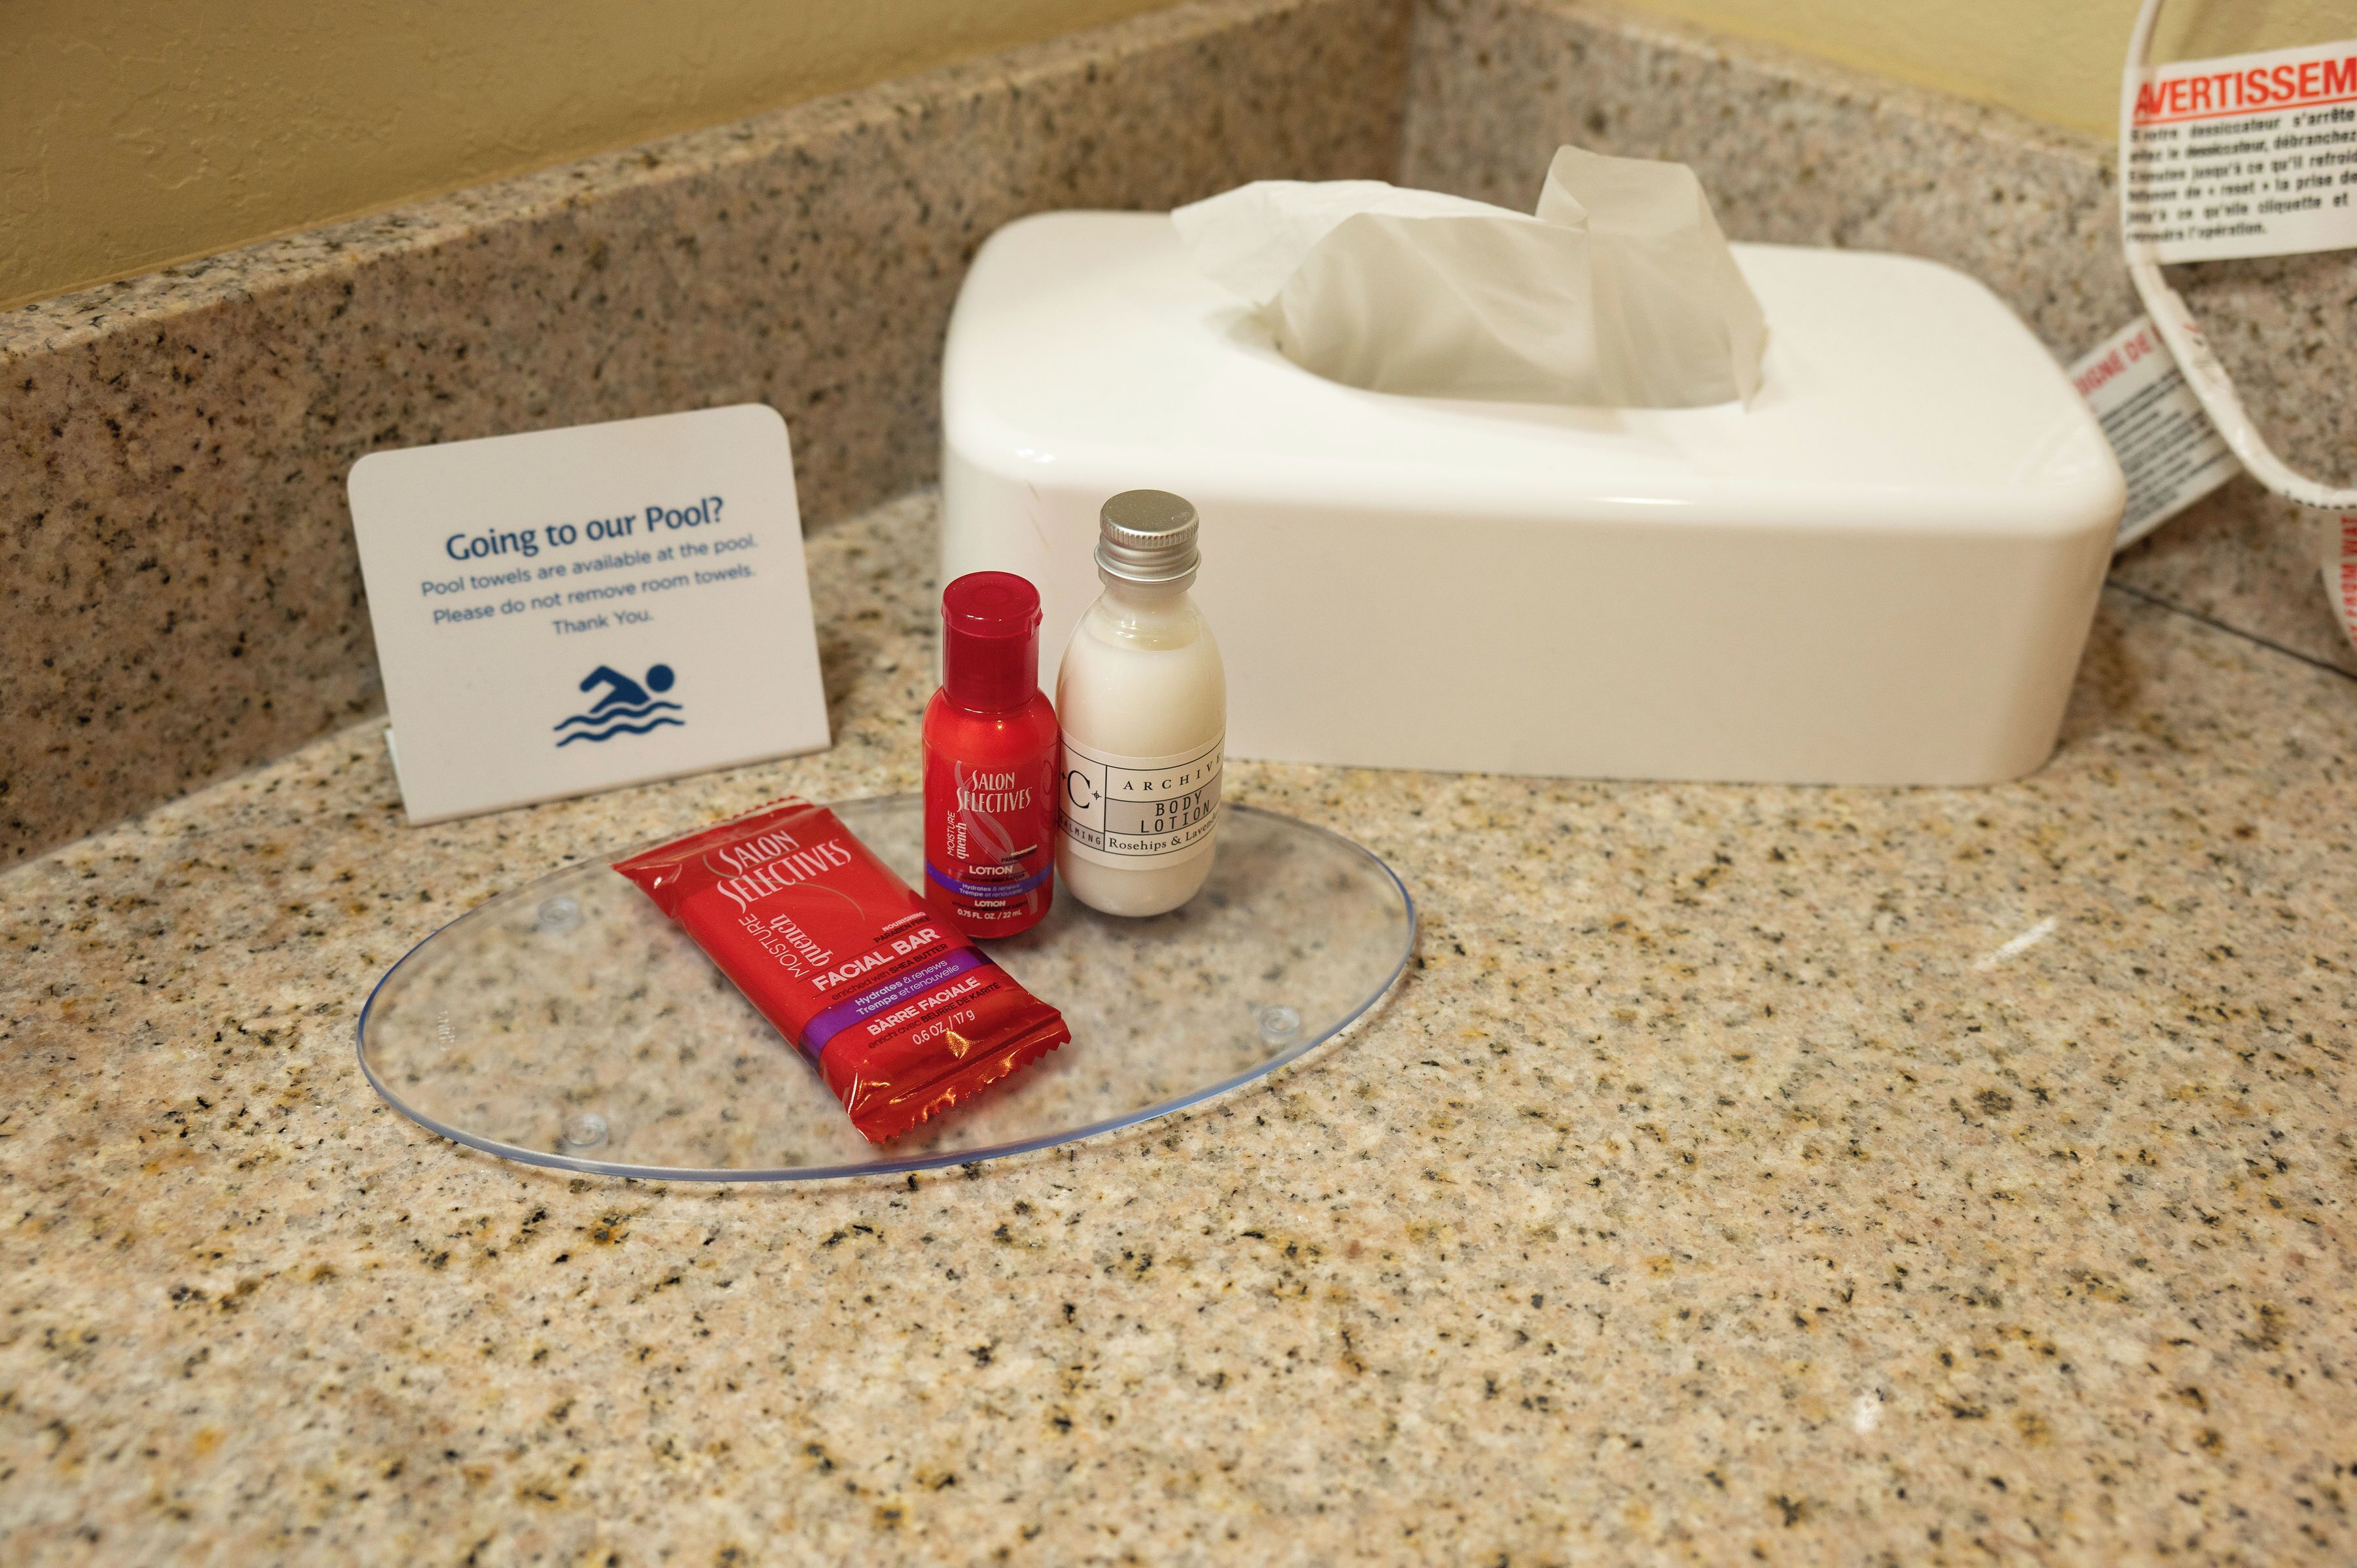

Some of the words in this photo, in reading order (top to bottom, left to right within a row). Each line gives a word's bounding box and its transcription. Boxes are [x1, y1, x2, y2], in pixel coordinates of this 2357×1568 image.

[446, 527, 539, 561] Going
[545, 524, 577, 547] to
[586, 515, 636, 541] our
[645, 495, 724, 533] Pool?
[421, 576, 466, 596] Pool
[469, 568, 532, 591] towels
[537, 564, 567, 581] are
[572, 549, 652, 575] available
[657, 545, 675, 562] at
[679, 541, 708, 558] the
[714, 532, 758, 556] pool.
[432, 604, 496, 625] Please
[500, 598, 526, 615] do
[531, 593, 562, 610] not
[568, 582, 637, 604] remove
[640, 574, 690, 593] room
[694, 562, 757, 585] towels.
[551, 613, 610, 637] Thank
[613, 610, 654, 626] You.
[972, 769, 1015, 791] SALON
[1122, 752, 1221, 792] ARCHIVE
[957, 787, 1032, 813] SELECTIVES
[1141, 799, 1210, 834] LOTION
[1154, 790, 1203, 817] BODY
[719, 830, 800, 876] SALON
[947, 811, 956, 857] MOISTURE
[957, 822, 970, 860] quench
[1108, 837, 1167, 852] Rosehips
[1171, 835, 1182, 847] &
[716, 839, 852, 915] SELECTIVES
[962, 883, 991, 892] Hydrates
[969, 864, 1014, 876] LOTION
[959, 888, 983, 897] Trempe
[873, 923, 913, 943] PARABEN
[911, 916, 932, 927] FREE
[881, 911, 926, 932] NOURISHING
[957, 908, 972, 917] 0.75
[738, 913, 810, 979] MOISTURE
[769, 913, 834, 967] quench
[811, 951, 895, 992] FACIAL
[890, 928, 941, 956] BAR
[831, 977, 873, 1000] enriched
[870, 970, 890, 984] with
[889, 959, 915, 974] SHEA
[913, 943, 949, 962] BUTTER
[854, 981, 904, 1007] Hydrates
[903, 975, 913, 984] &
[911, 960, 948, 979] renews
[856, 993, 898, 1017] Trempe
[899, 987, 911, 996] et
[911, 964, 960, 991] renouvelle
[868, 1031, 898, 1049] enrichi
[897, 1020, 923, 1036] avec
[921, 1002, 959, 1025] BEURRE
[955, 996, 971, 1007] DE
[911, 1029, 930, 1046] 0.6
[947, 1015, 954, 1031] /
[952, 1012, 966, 1025] 17
[965, 1009, 976, 1021] g
